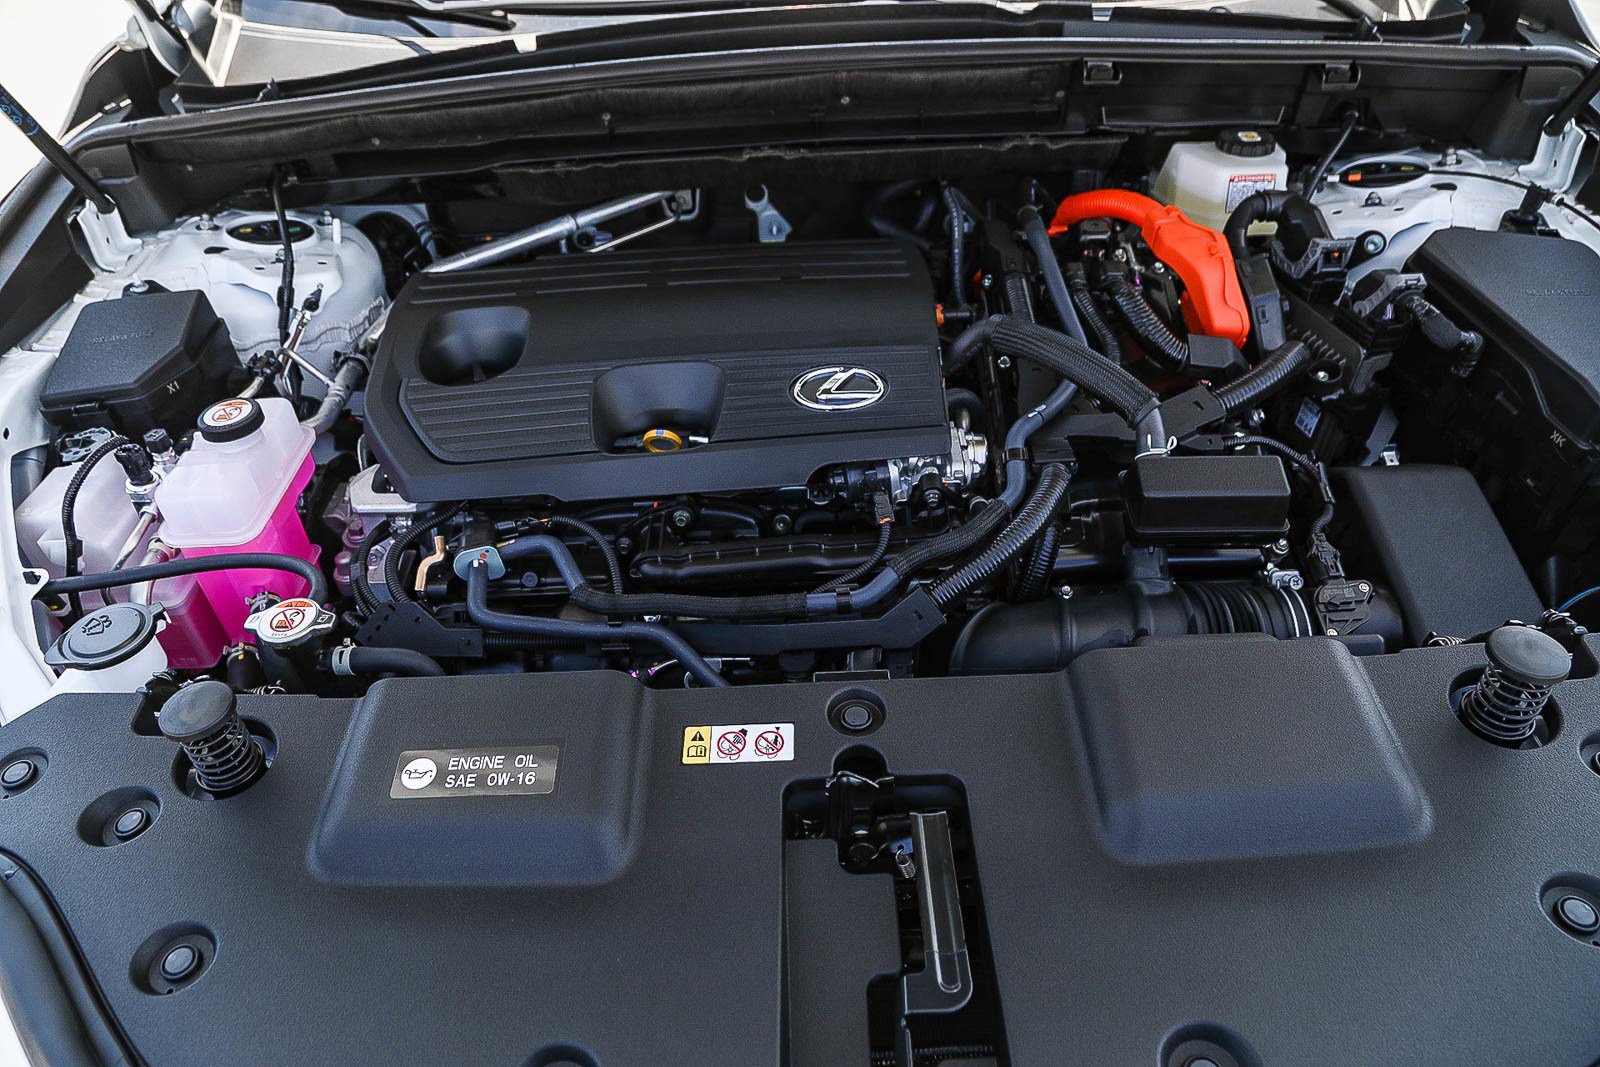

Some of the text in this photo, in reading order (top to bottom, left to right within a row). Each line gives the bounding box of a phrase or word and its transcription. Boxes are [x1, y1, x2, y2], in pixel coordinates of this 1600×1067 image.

[448, 754, 538, 771] ENGINE OIL
[444, 771, 536, 788] SAE 0W-16
